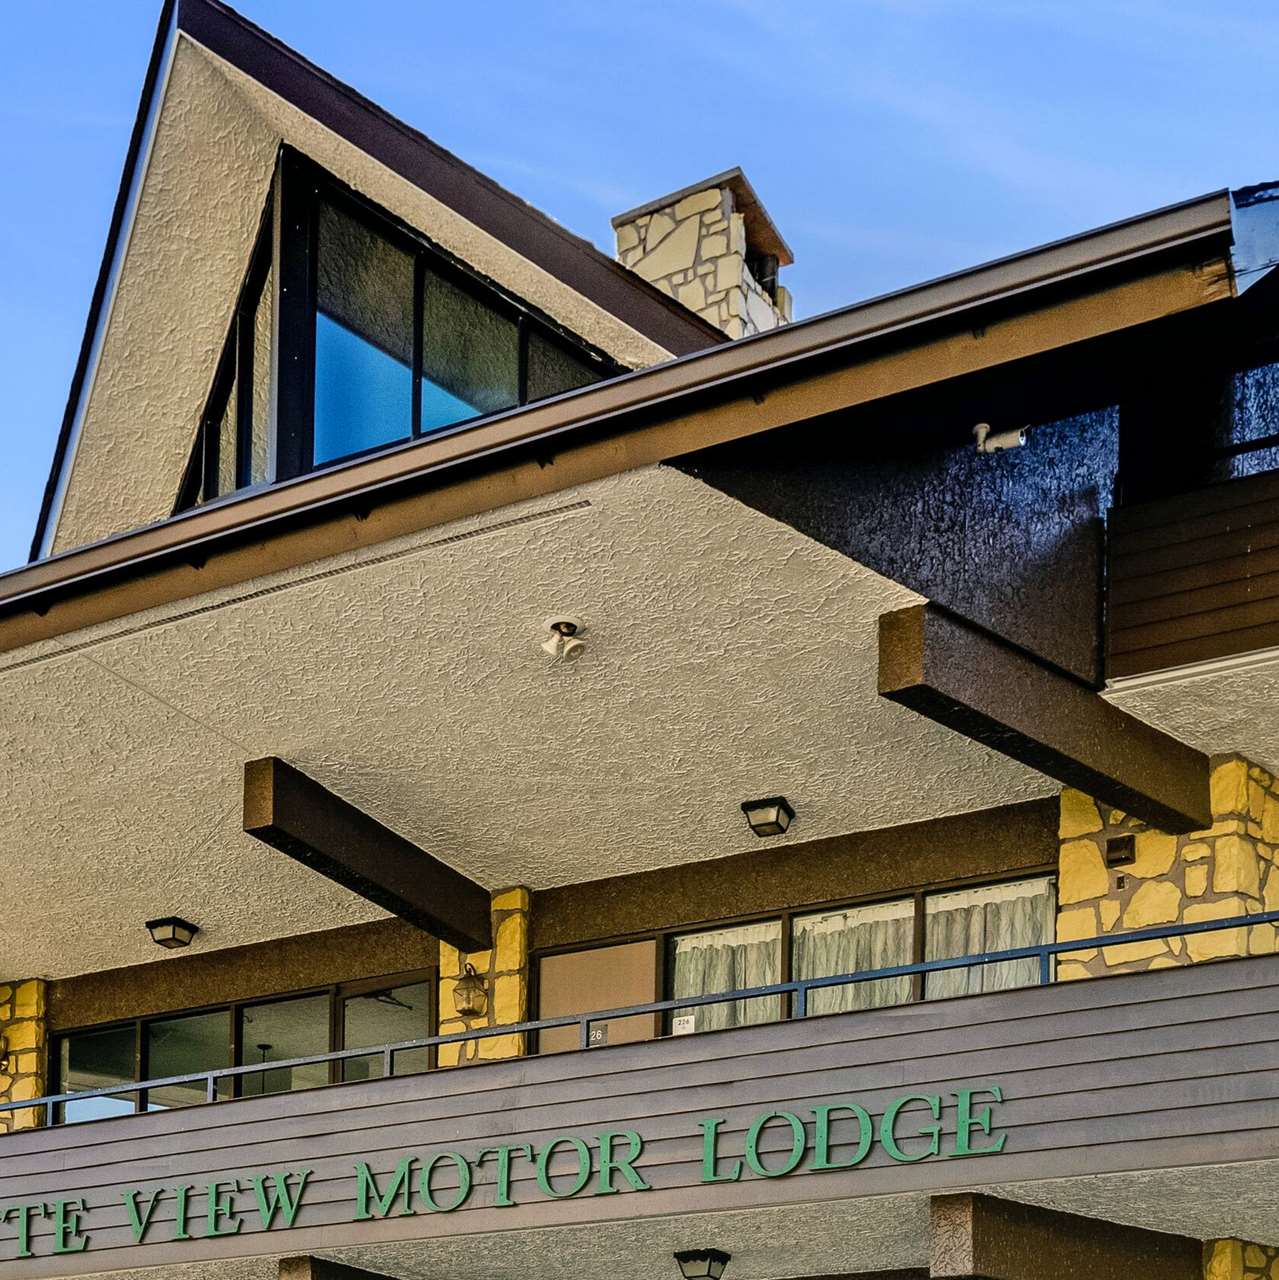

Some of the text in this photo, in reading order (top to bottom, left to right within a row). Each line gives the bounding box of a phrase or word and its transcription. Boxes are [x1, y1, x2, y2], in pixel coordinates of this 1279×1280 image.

[122, 1168, 314, 1245] VIEW
[352, 1129, 652, 1222] MOTOR
[697, 1084, 1007, 1185] LODGE
